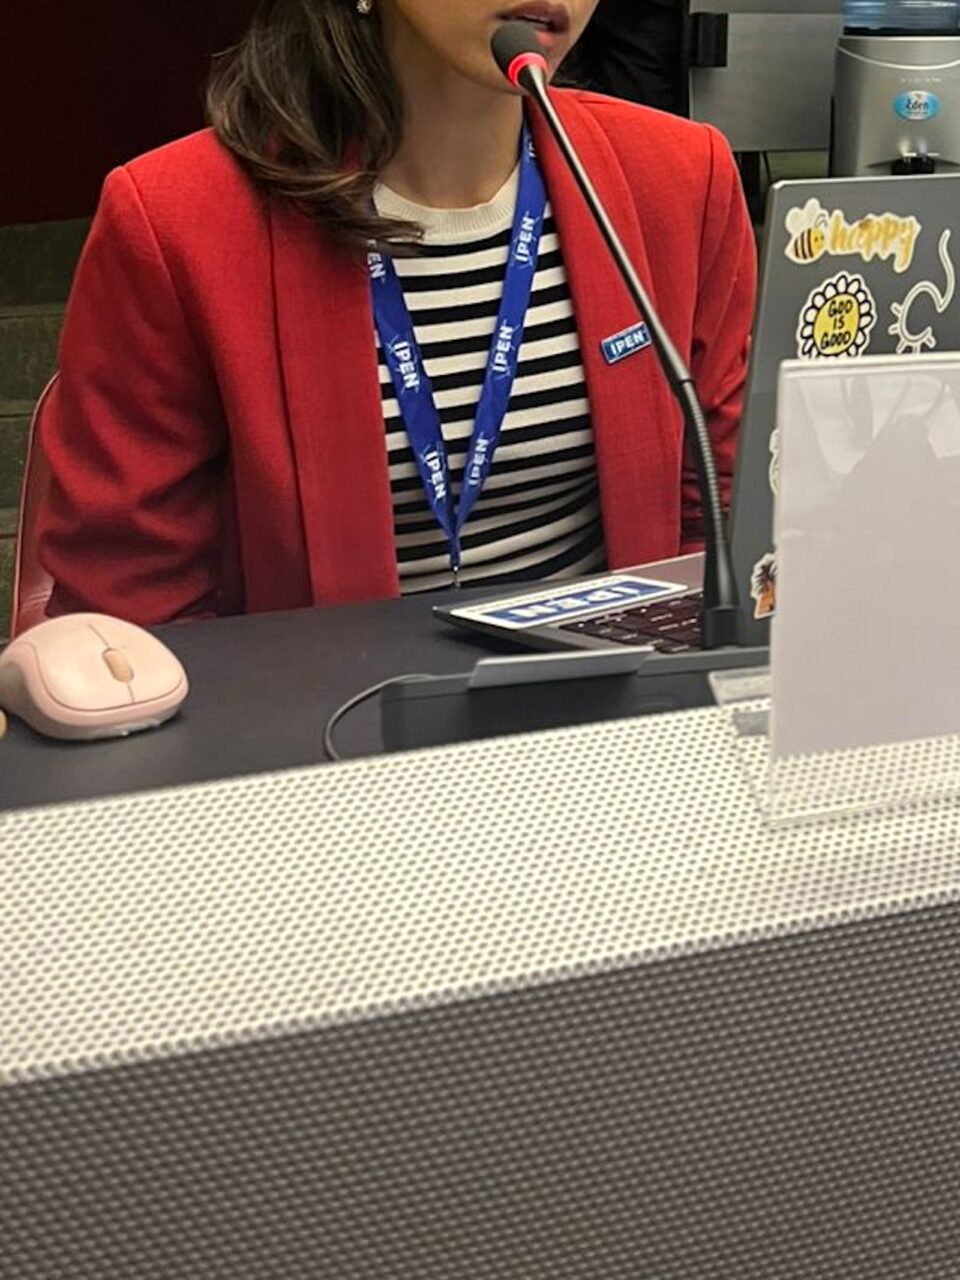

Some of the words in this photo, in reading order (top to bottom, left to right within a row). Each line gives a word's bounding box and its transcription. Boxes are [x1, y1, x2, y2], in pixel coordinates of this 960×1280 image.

[514, 216, 535, 262] IPEN
[831, 211, 917, 270] happy
[828, 299, 854, 318] GOD
[833, 315, 846, 330] IS
[492, 325, 513, 372] IPEN
[610, 329, 645, 355] IPEN
[820, 330, 852, 351] GOOD
[394, 341, 419, 389] IPEN
[425, 450, 446, 499] IPEN
[468, 437, 489, 486] IPEN
